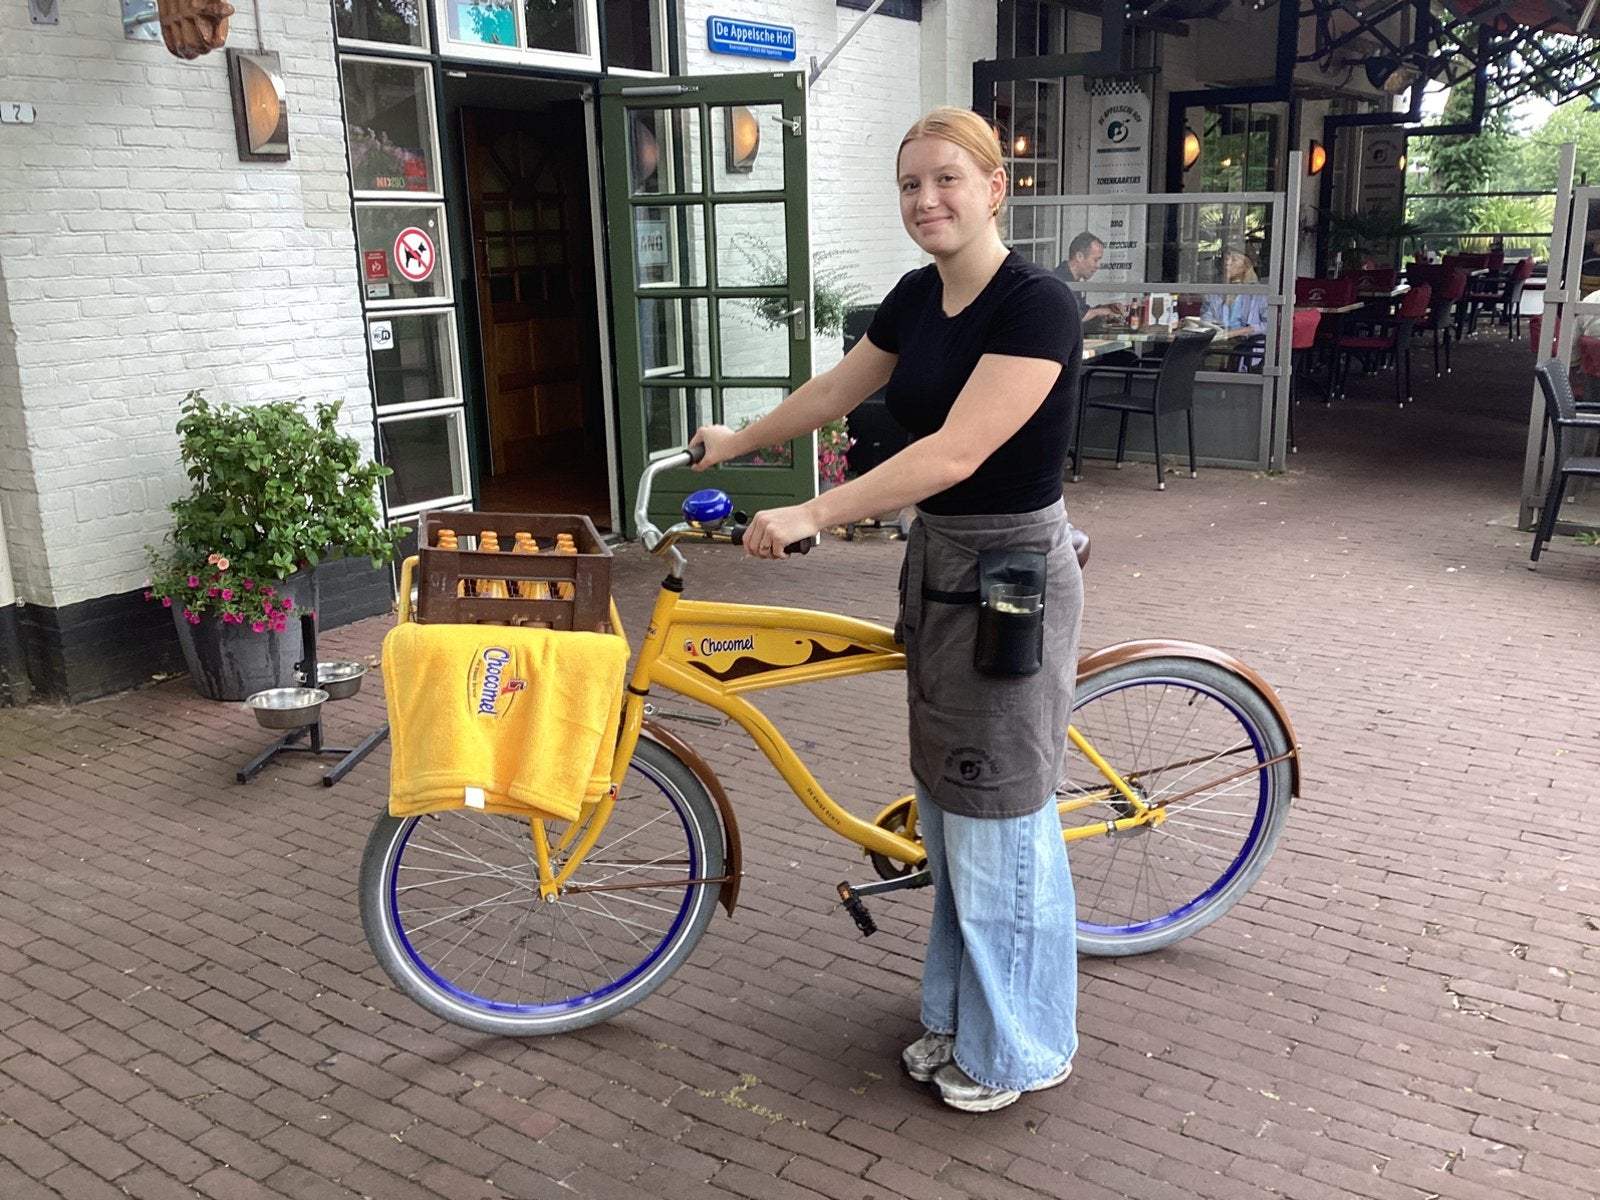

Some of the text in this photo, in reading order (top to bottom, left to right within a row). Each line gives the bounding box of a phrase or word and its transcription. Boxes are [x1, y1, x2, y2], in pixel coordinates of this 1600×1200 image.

[716, 22, 792, 45] De Appelsche Hof
[12, 104, 21, 121] 7
[701, 635, 755, 657] Chocomel
[477, 647, 511, 715] Chocomel
